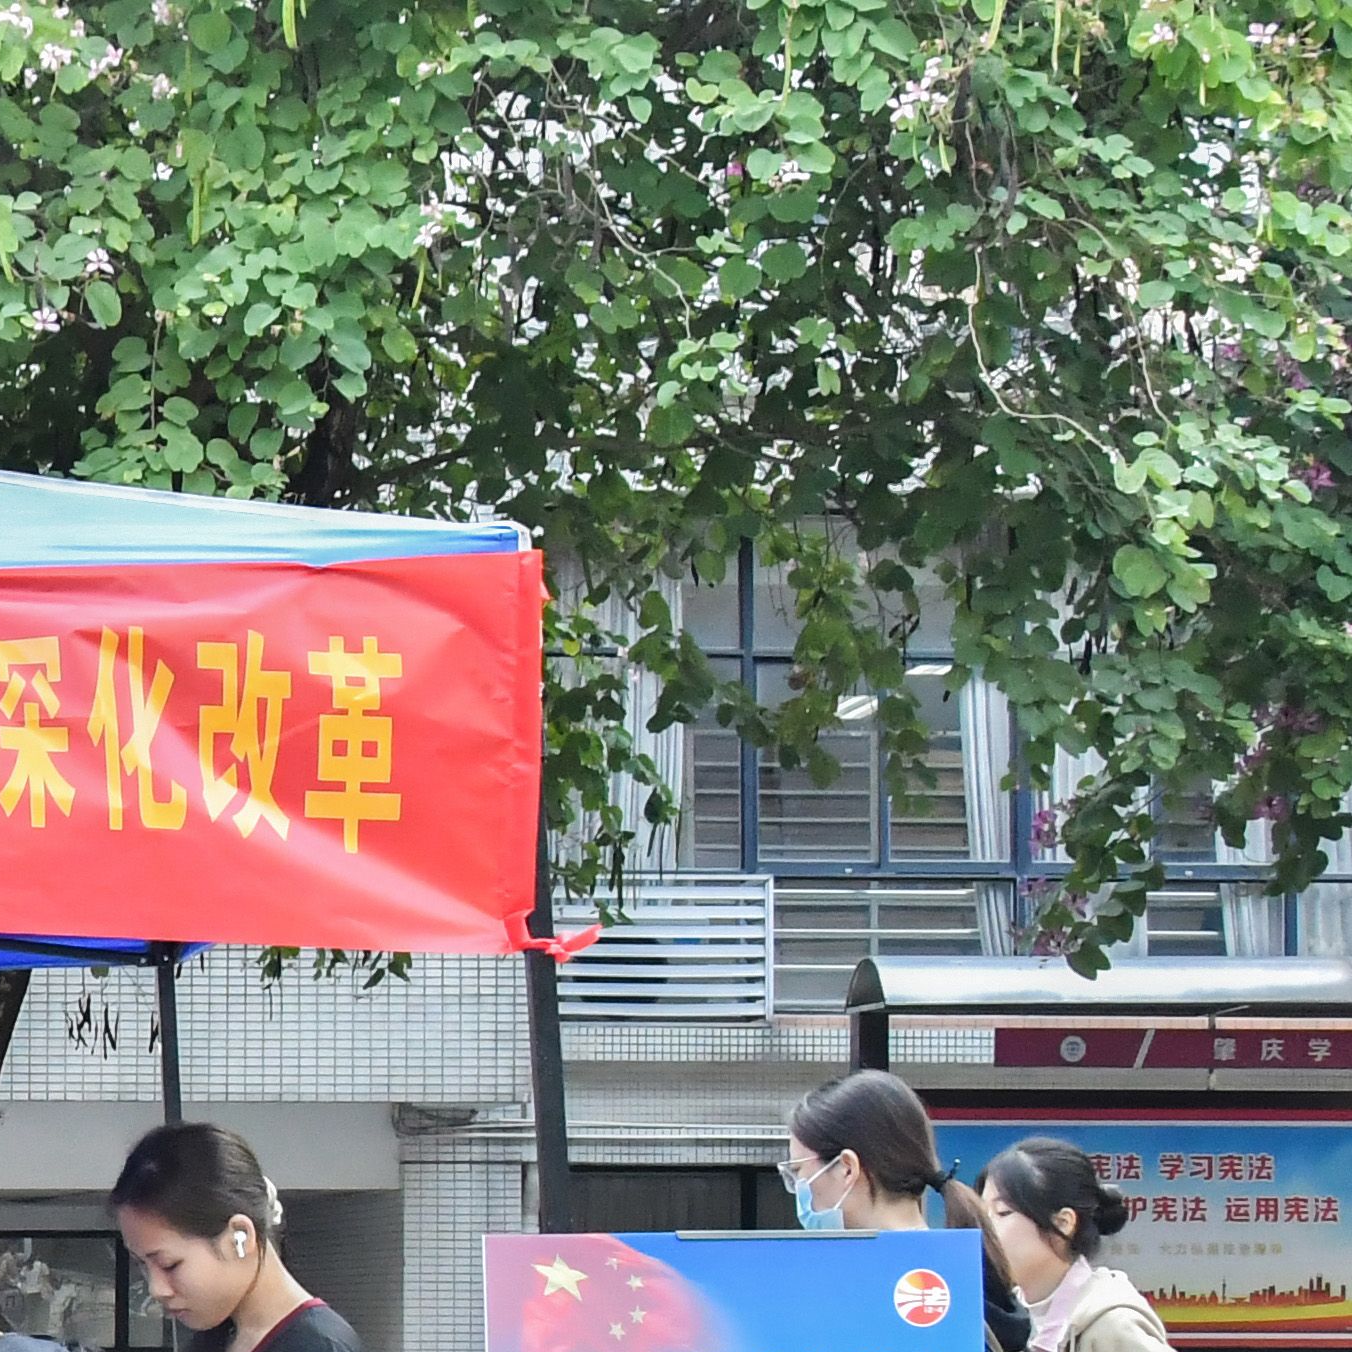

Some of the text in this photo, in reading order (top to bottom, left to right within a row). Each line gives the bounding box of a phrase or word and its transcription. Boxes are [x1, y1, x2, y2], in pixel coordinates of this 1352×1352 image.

[1159, 1154, 1274, 1181] 学习宪法
[1225, 1196, 1339, 1223] 运用宪法
